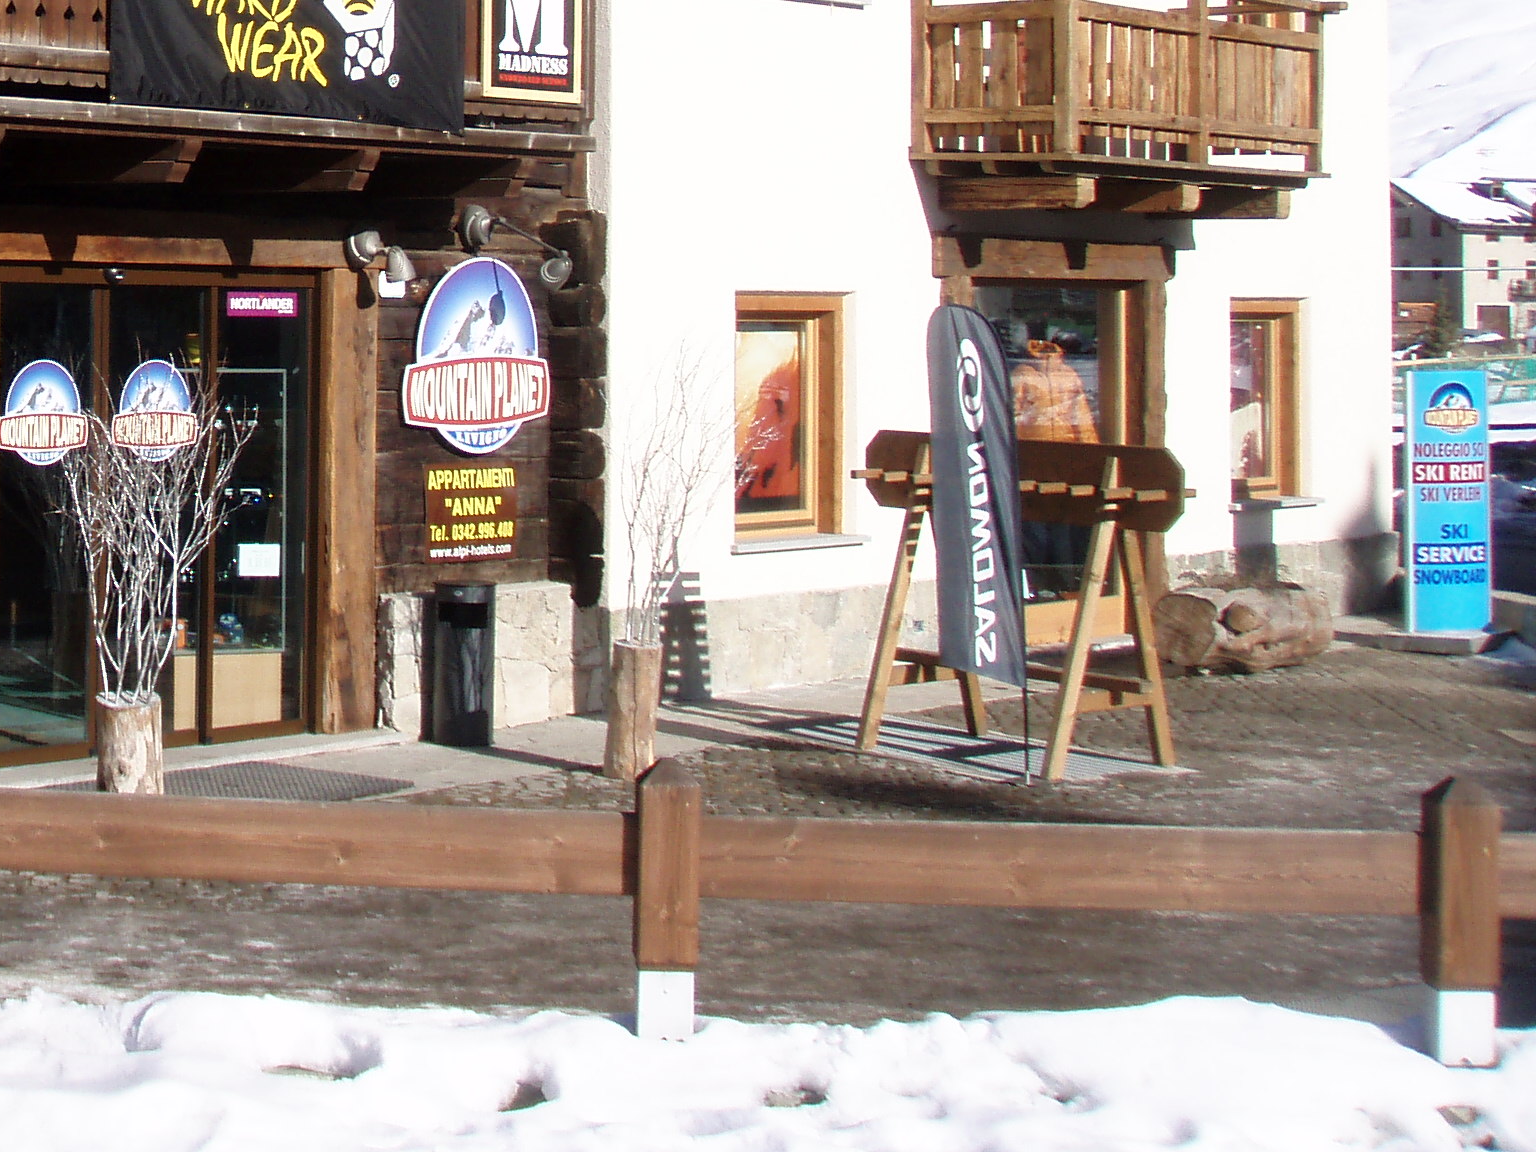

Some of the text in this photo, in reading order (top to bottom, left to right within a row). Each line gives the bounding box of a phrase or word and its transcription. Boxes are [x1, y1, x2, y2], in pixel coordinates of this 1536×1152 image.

[217, 12, 328, 88] WEAR
[498, 52, 569, 76] MADNESS
[230, 297, 294, 310] NORTLANDER
[412, 361, 544, 421] MOUNTAIN PLANET
[1, 415, 85, 448] MOUNTAIN PLANET
[164, 414, 194, 445] PLANET
[1414, 442, 1470, 457] NOLEGGIO
[427, 468, 515, 490] APPARTAMENTI
[1415, 463, 1484, 481] SKI RENT
[1420, 487, 1439, 502] SKI
[444, 496, 502, 516] "ANNA"
[429, 524, 449, 542] Tel.
[1440, 523, 1468, 539] SKI
[1417, 545, 1486, 563] SERVICE
[1413, 569, 1486, 585] SNOWBOARD
